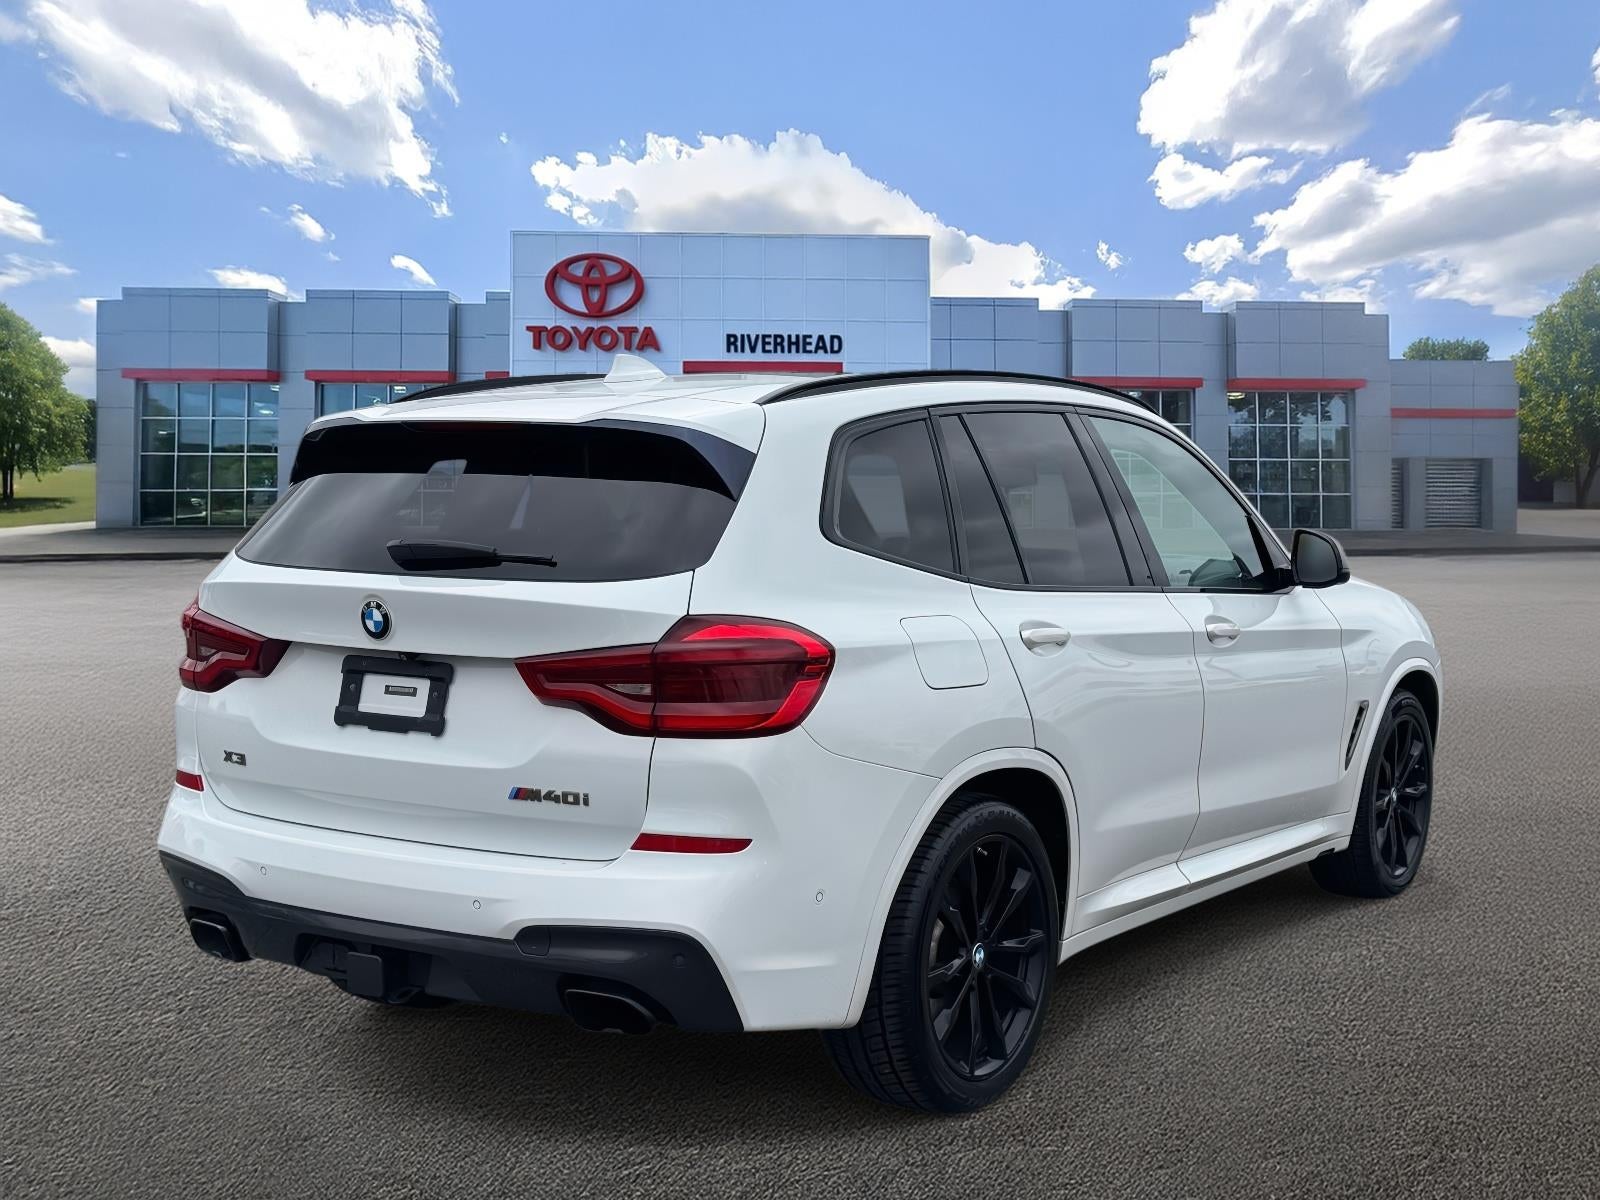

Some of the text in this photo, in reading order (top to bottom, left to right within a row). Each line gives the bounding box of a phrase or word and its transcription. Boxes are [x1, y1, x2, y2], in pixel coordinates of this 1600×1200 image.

[526, 325, 661, 352] TOYOTA
[726, 333, 843, 355] RIVERHEAD
[223, 749, 247, 766] X3
[522, 787, 590, 807] M40i
